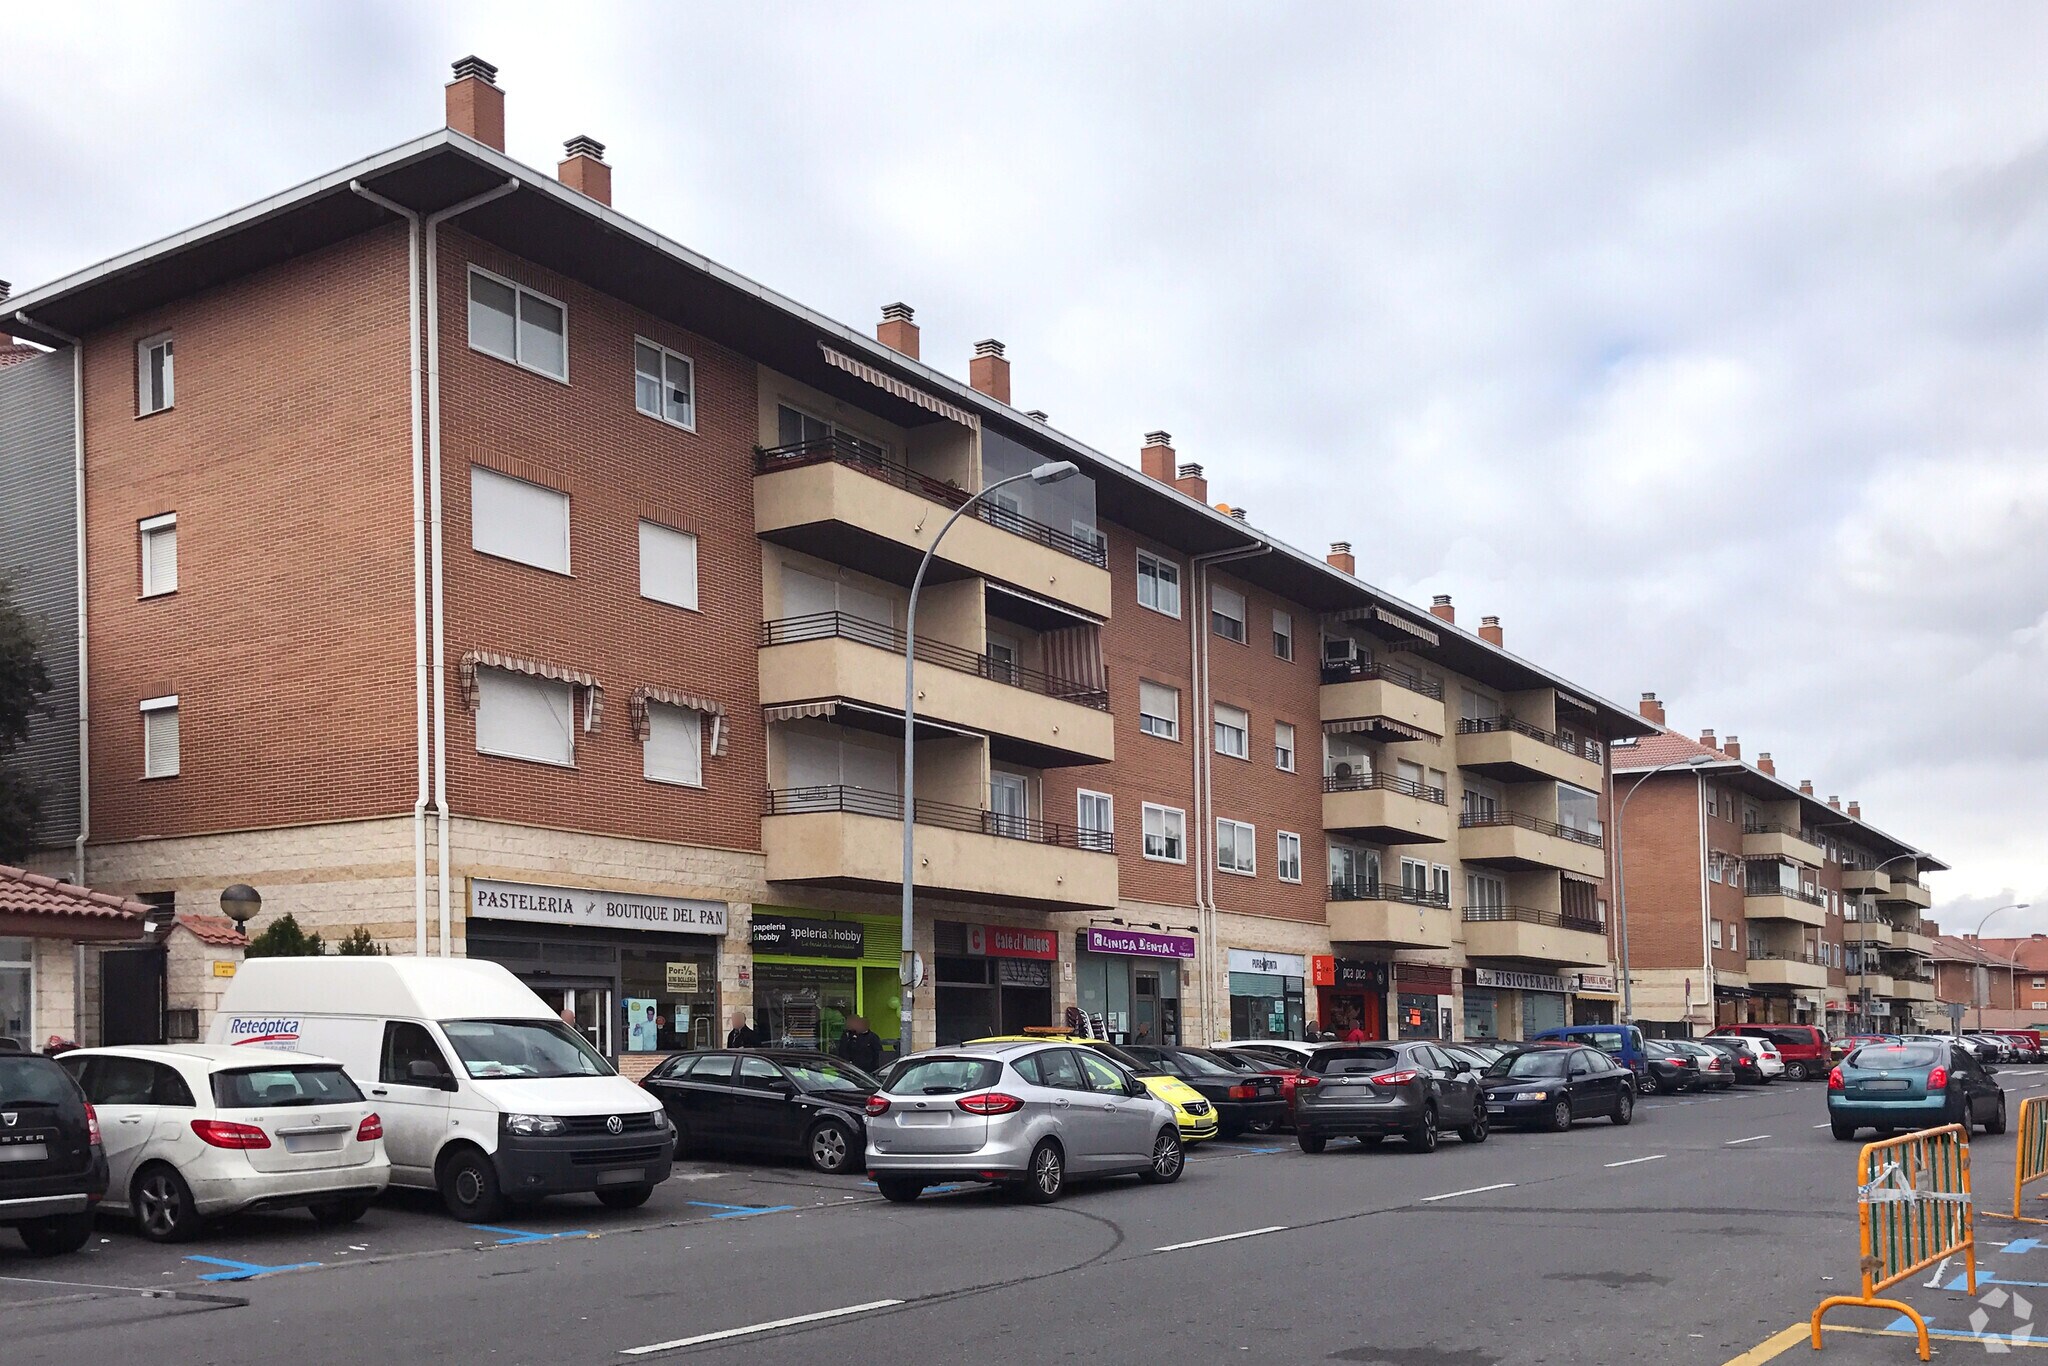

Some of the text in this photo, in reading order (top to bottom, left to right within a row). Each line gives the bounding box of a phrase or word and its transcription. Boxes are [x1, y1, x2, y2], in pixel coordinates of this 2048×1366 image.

[477, 890, 574, 914] PASTELERIA
[606, 902, 723, 926] BOUTIQUE DEL PAN
[1495, 971, 1565, 991] FISIOTERAPIA
[231, 1018, 299, 1036] Reteóptica
